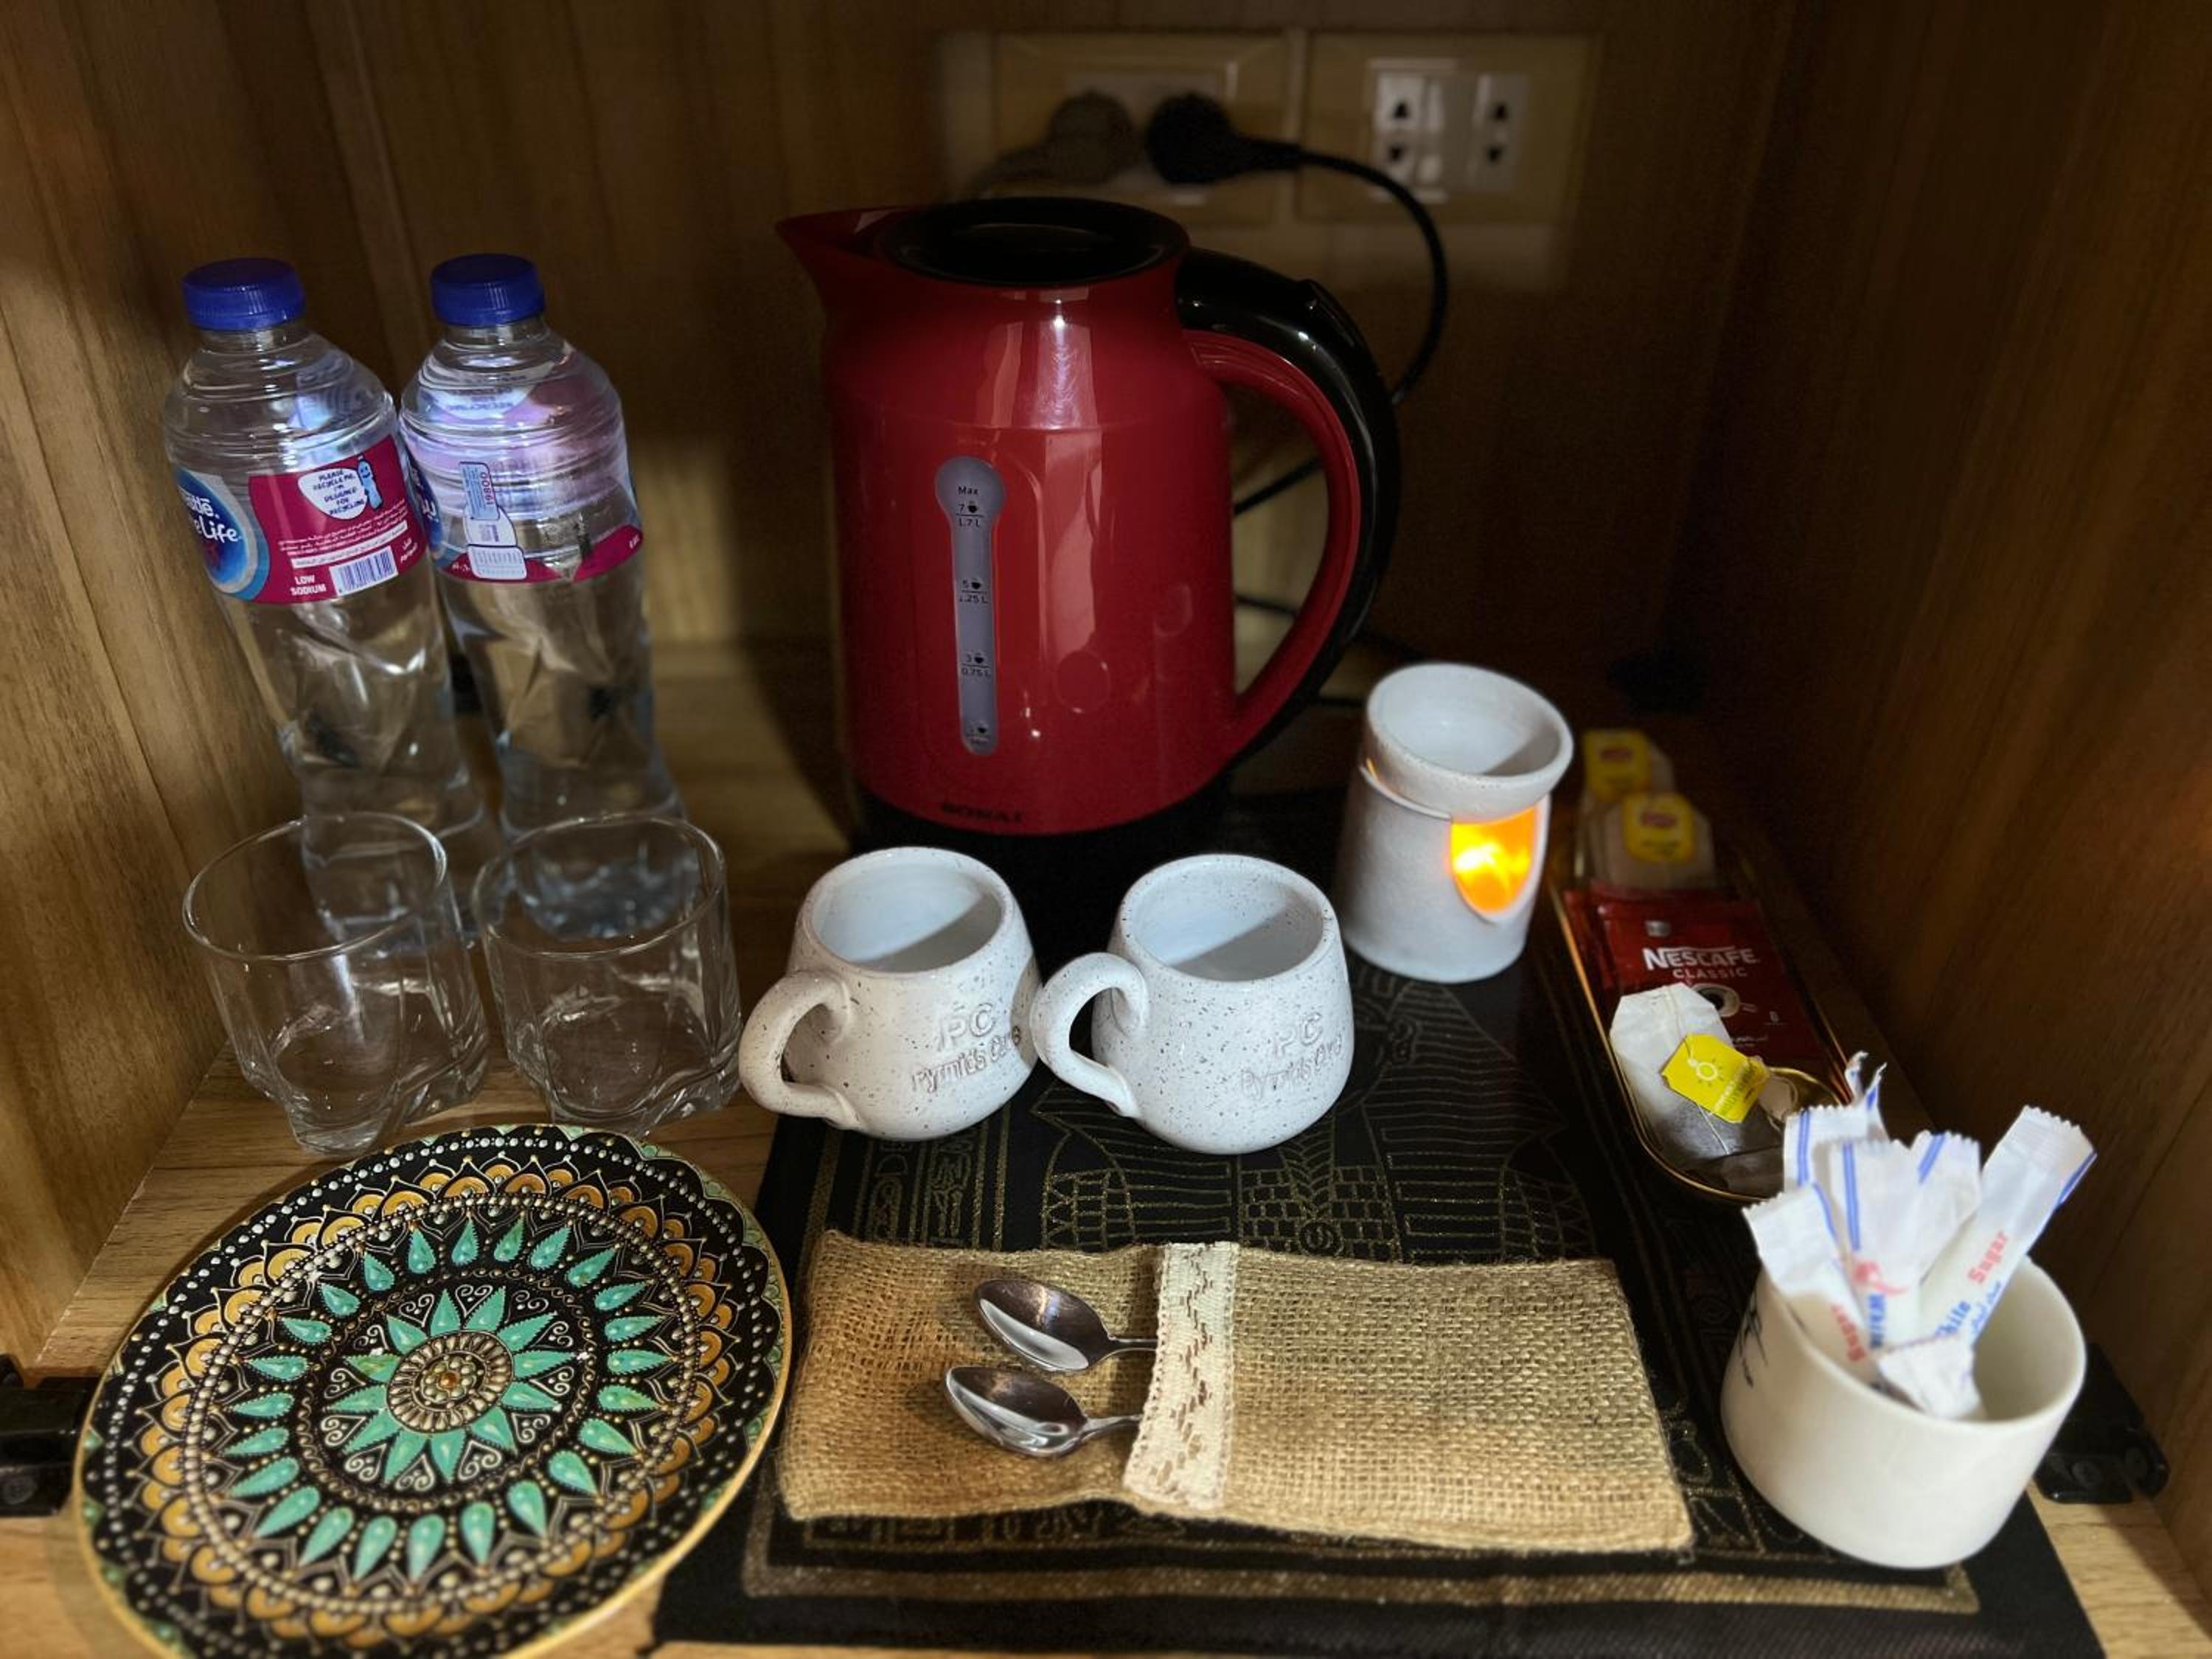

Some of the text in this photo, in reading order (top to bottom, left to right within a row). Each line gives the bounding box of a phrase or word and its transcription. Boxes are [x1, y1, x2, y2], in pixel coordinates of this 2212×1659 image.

[958, 486, 978, 495] Max
[198, 515, 238, 543] Life
[290, 583, 327, 597] SODIUM
[295, 574, 315, 586] LOW
[1672, 967, 1748, 979] CLASSIC
[936, 1003, 996, 1052] PC
[1274, 1012, 1322, 1060] PC
[1966, 1230, 2008, 1284] Sugar
